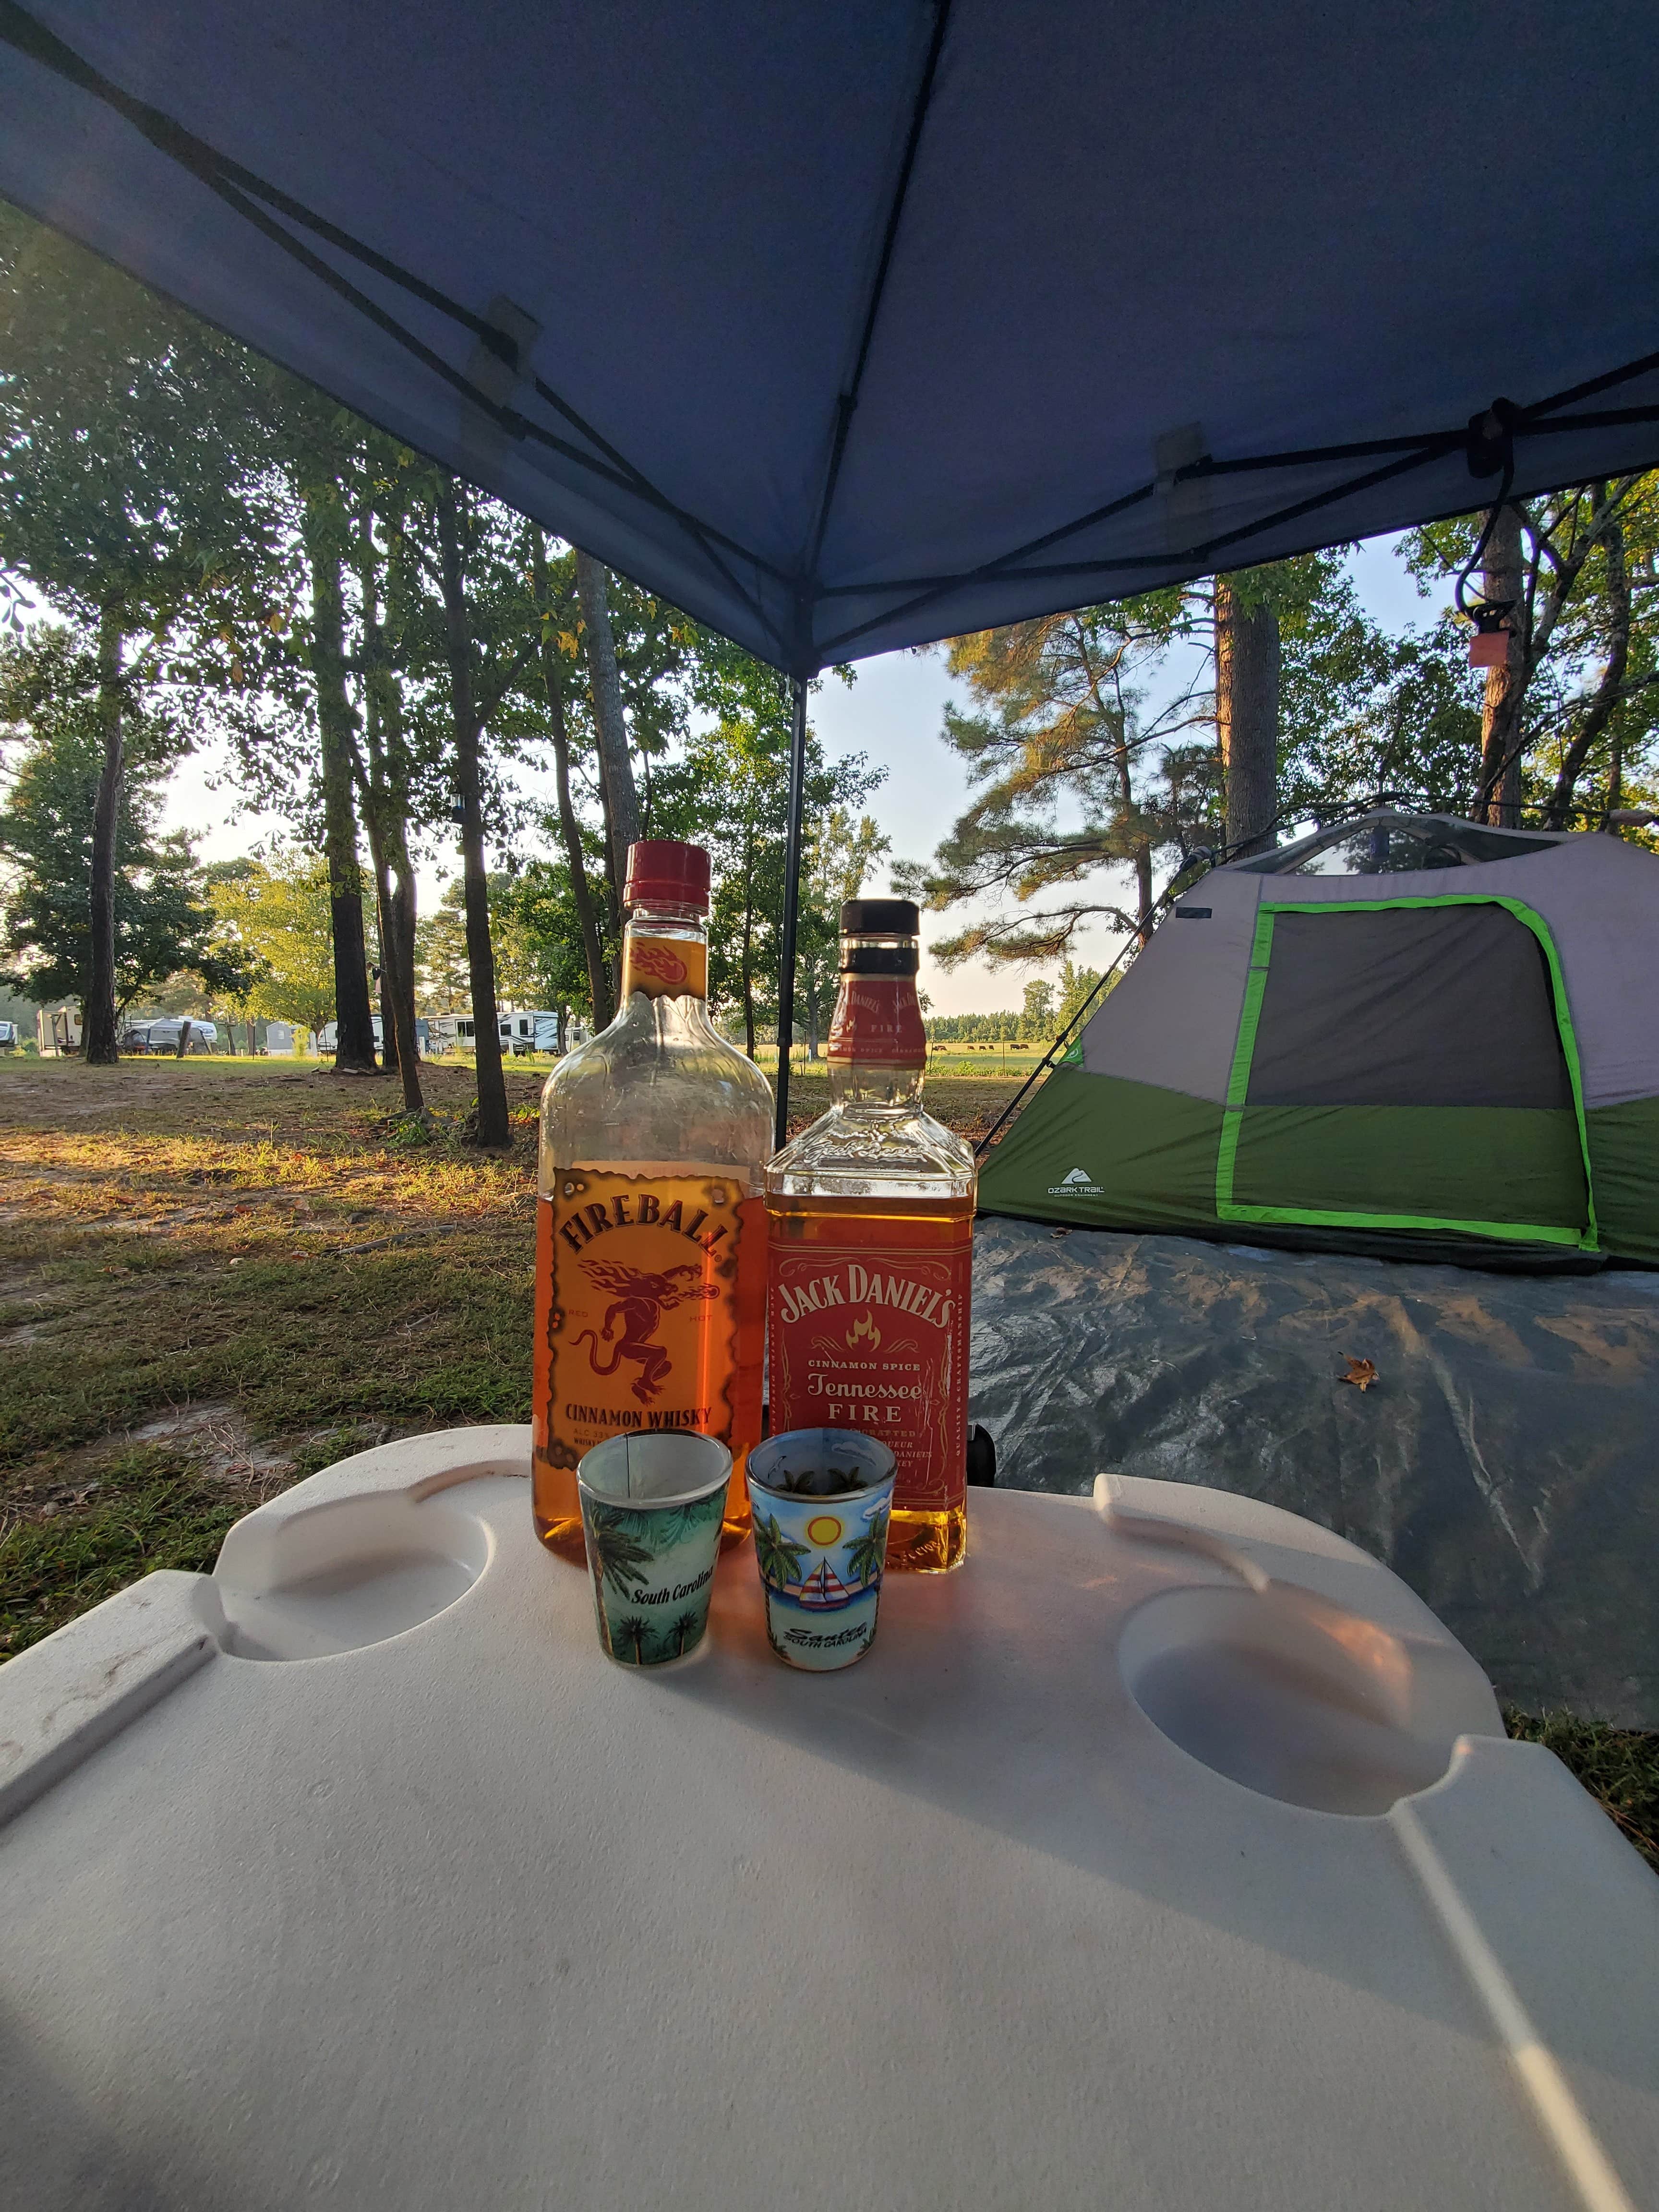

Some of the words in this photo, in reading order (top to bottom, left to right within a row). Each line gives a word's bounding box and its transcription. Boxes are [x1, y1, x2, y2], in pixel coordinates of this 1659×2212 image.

[559, 1194, 728, 1257] FIREBALL
[778, 1274, 846, 1323] JACK
[847, 1264, 956, 1328] DANIEL'S
[568, 1310, 588, 1318] RED
[808, 1359, 877, 1370] CINNAMON
[808, 1373, 922, 1399] Tennessee
[566, 1403, 642, 1428] CINNAMON
[647, 1407, 712, 1429] WHISKY
[828, 1403, 902, 1422] FIRE
[631, 1587, 670, 1605] South
[673, 1565, 713, 1601] Carolina
[783, 1632, 822, 1648] SOUTH
